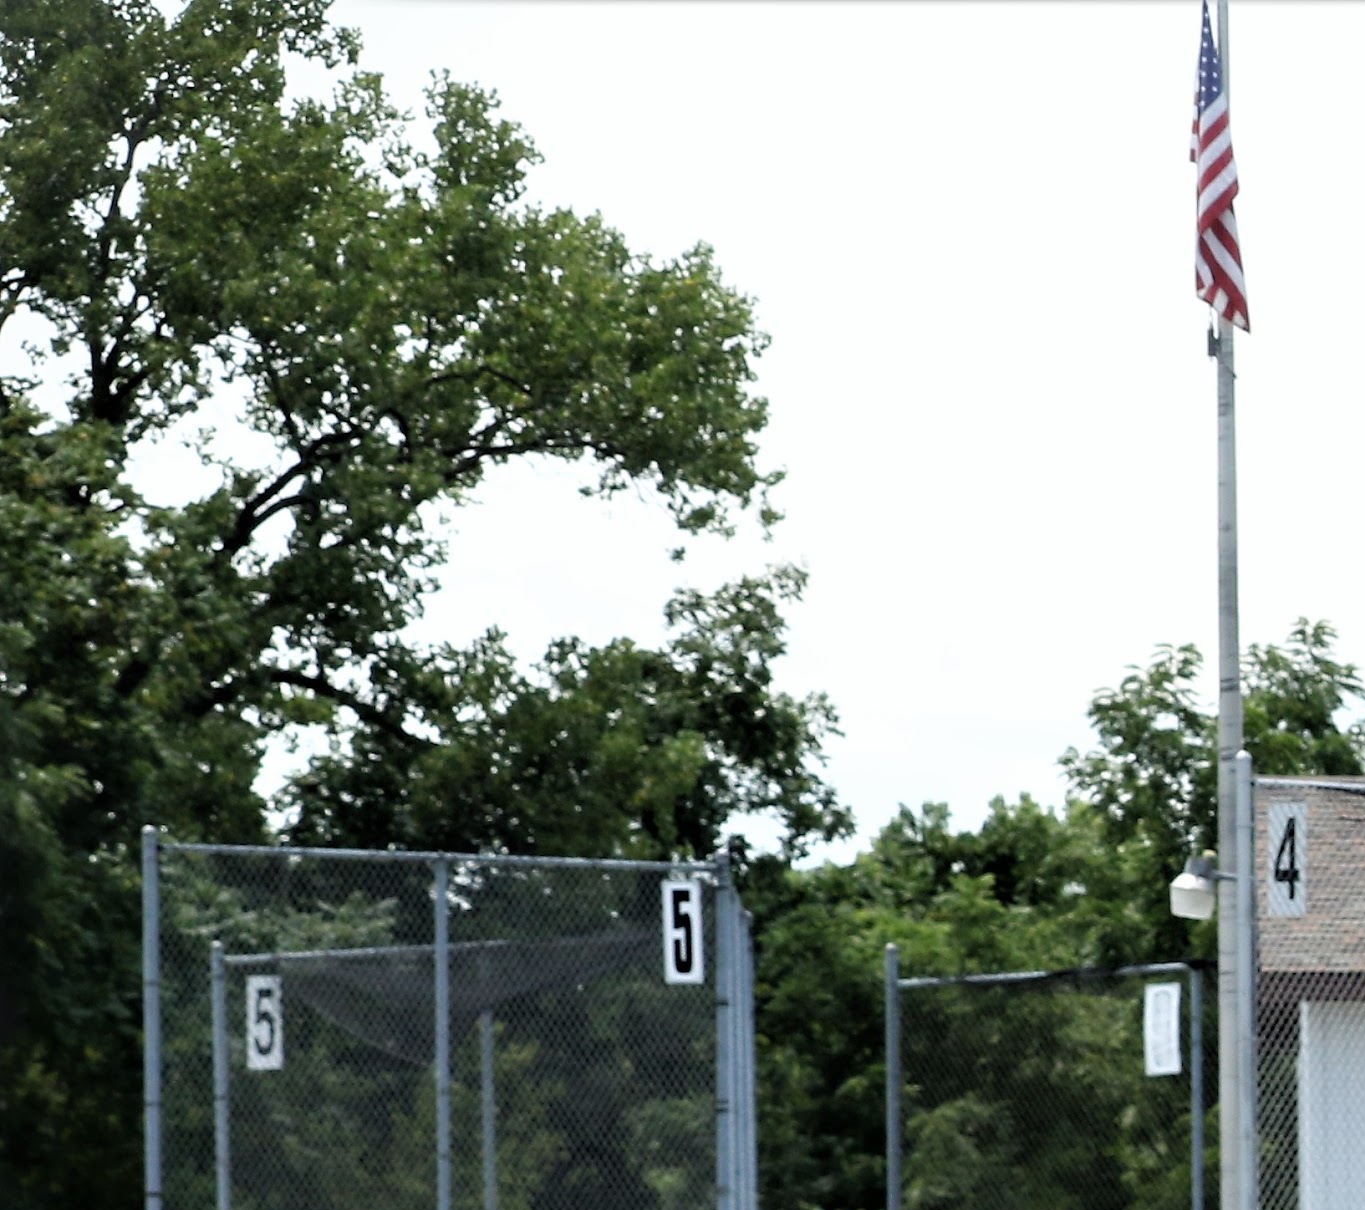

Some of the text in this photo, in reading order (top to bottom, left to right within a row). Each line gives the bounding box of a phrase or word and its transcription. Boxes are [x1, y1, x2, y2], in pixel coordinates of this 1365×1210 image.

[1275, 817, 1300, 900] 4
[672, 890, 692, 973] 5
[255, 989, 274, 1055] 5
